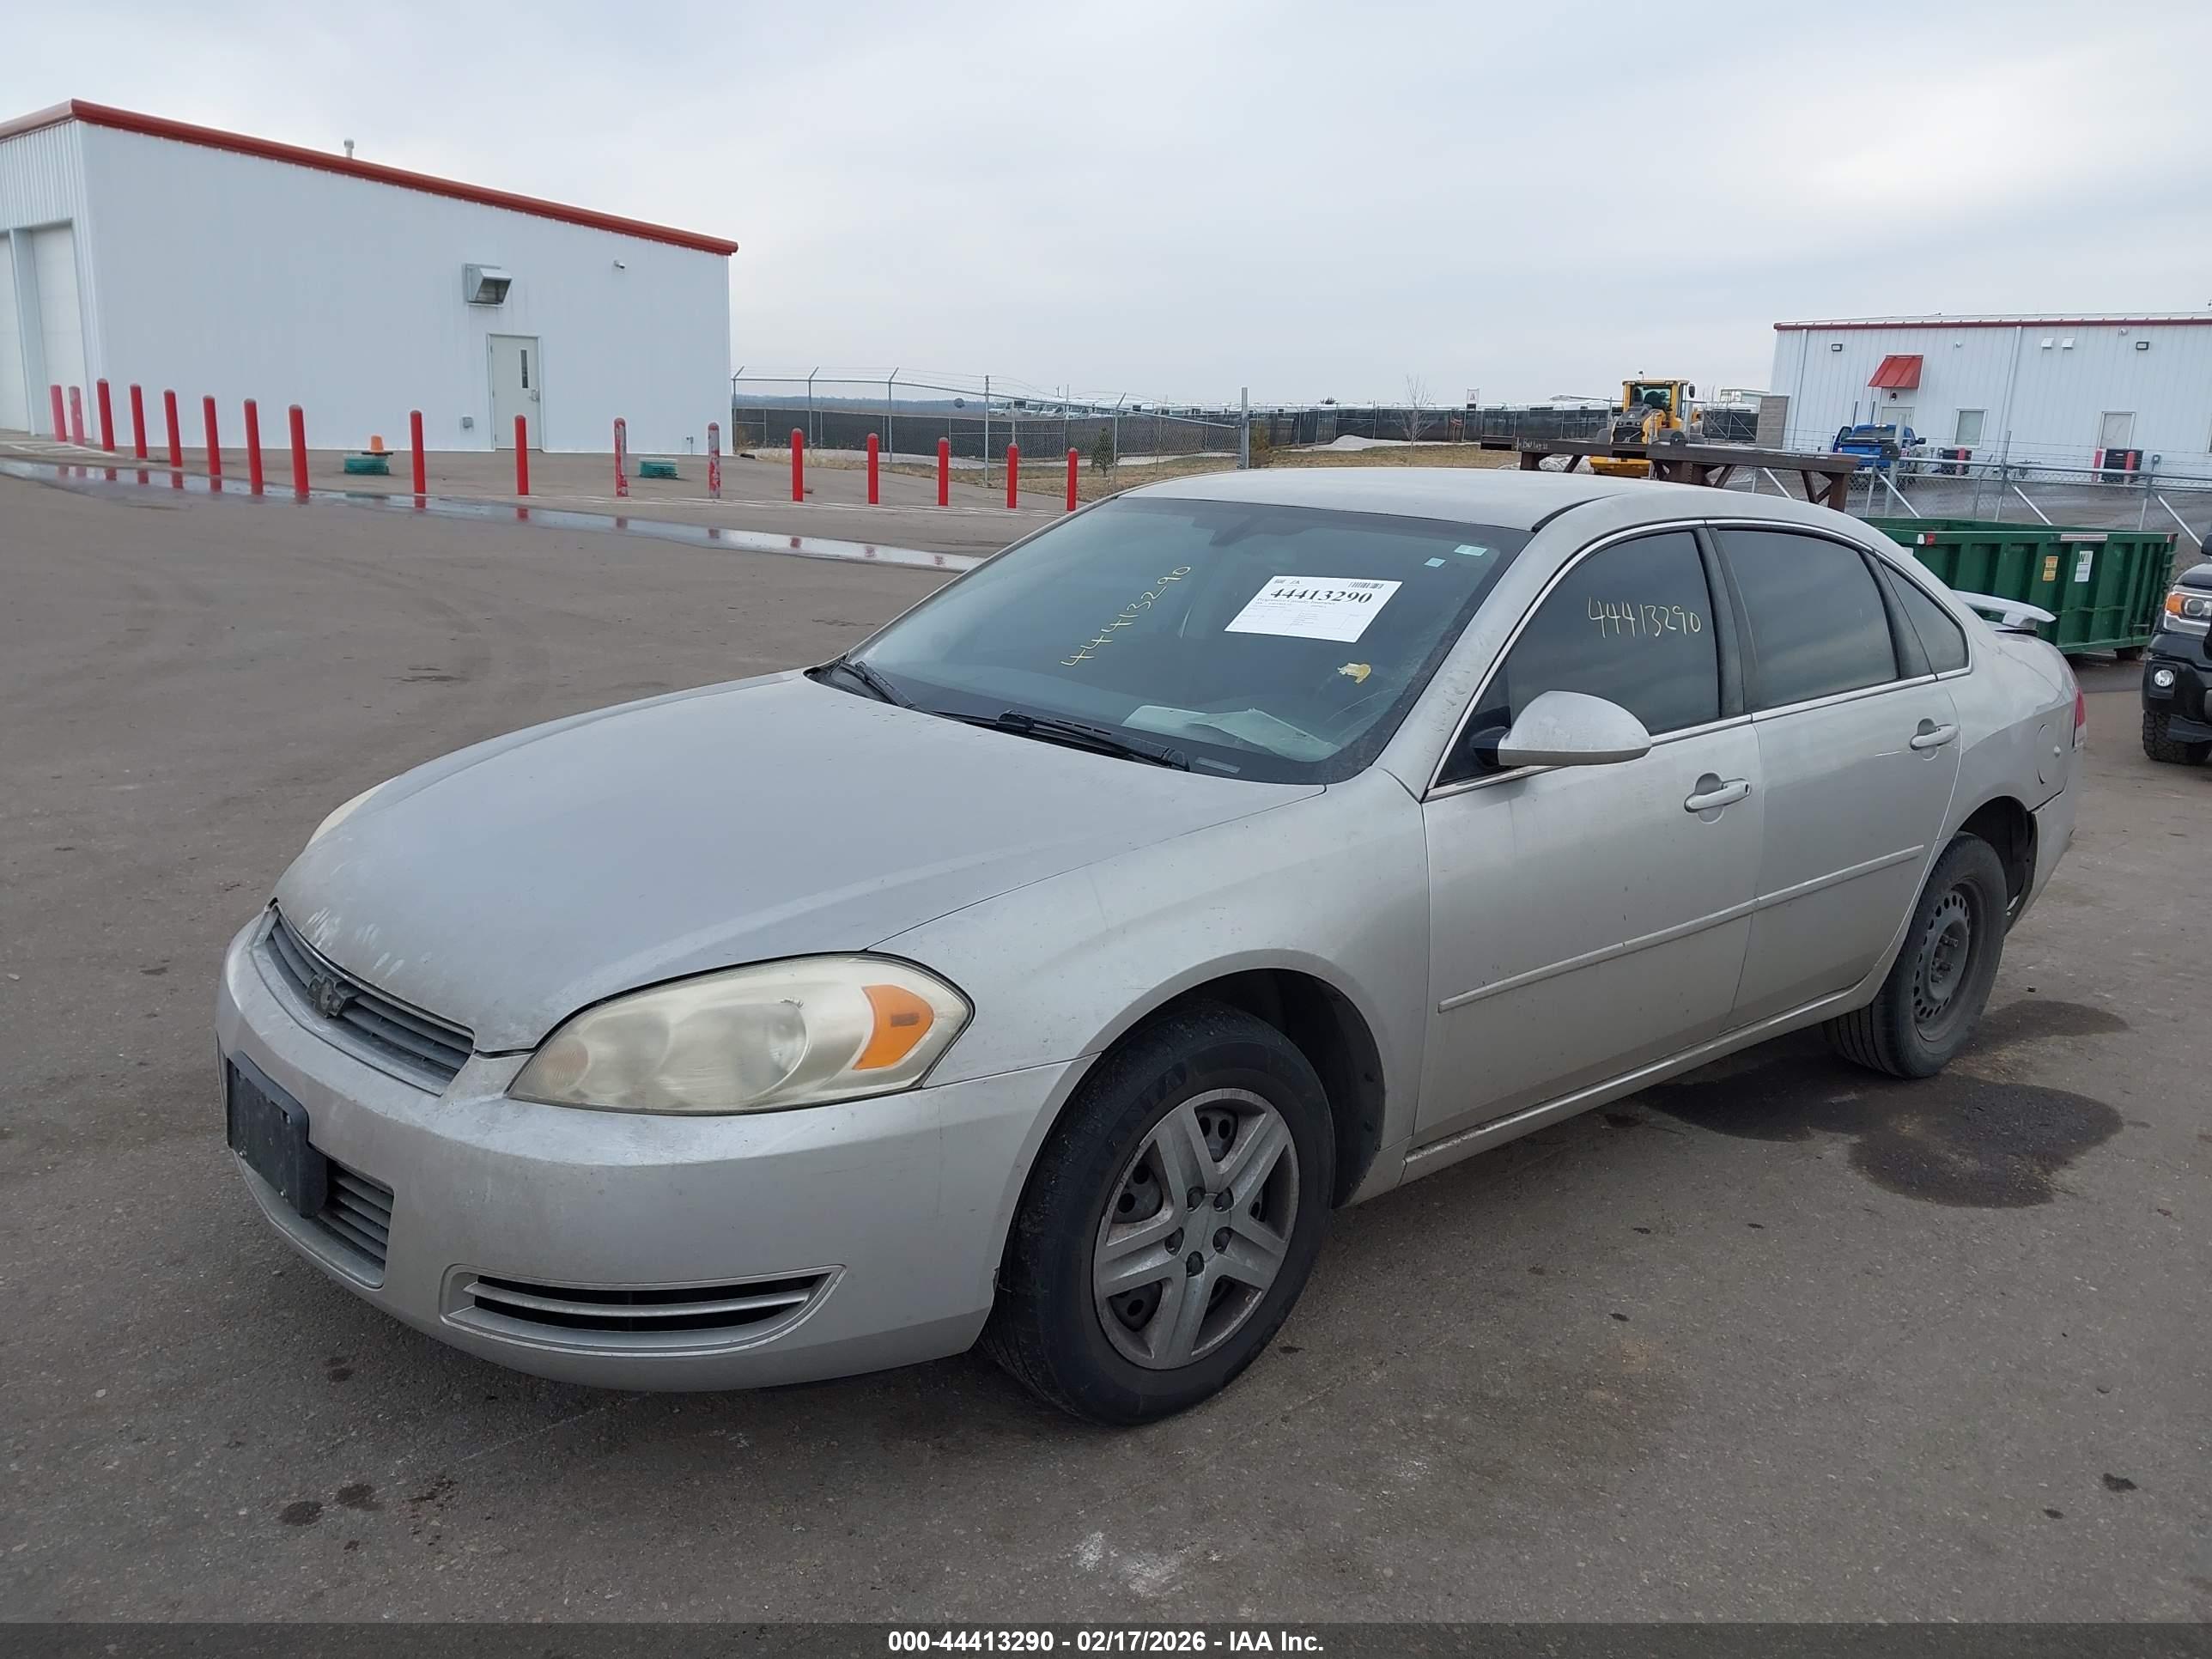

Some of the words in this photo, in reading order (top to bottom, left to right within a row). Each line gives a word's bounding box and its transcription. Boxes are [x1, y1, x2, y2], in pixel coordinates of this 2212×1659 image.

[1060, 566, 1191, 666] 44413290
[1270, 588, 1373, 604] 44413290
[1589, 597, 1702, 638] 44413290
